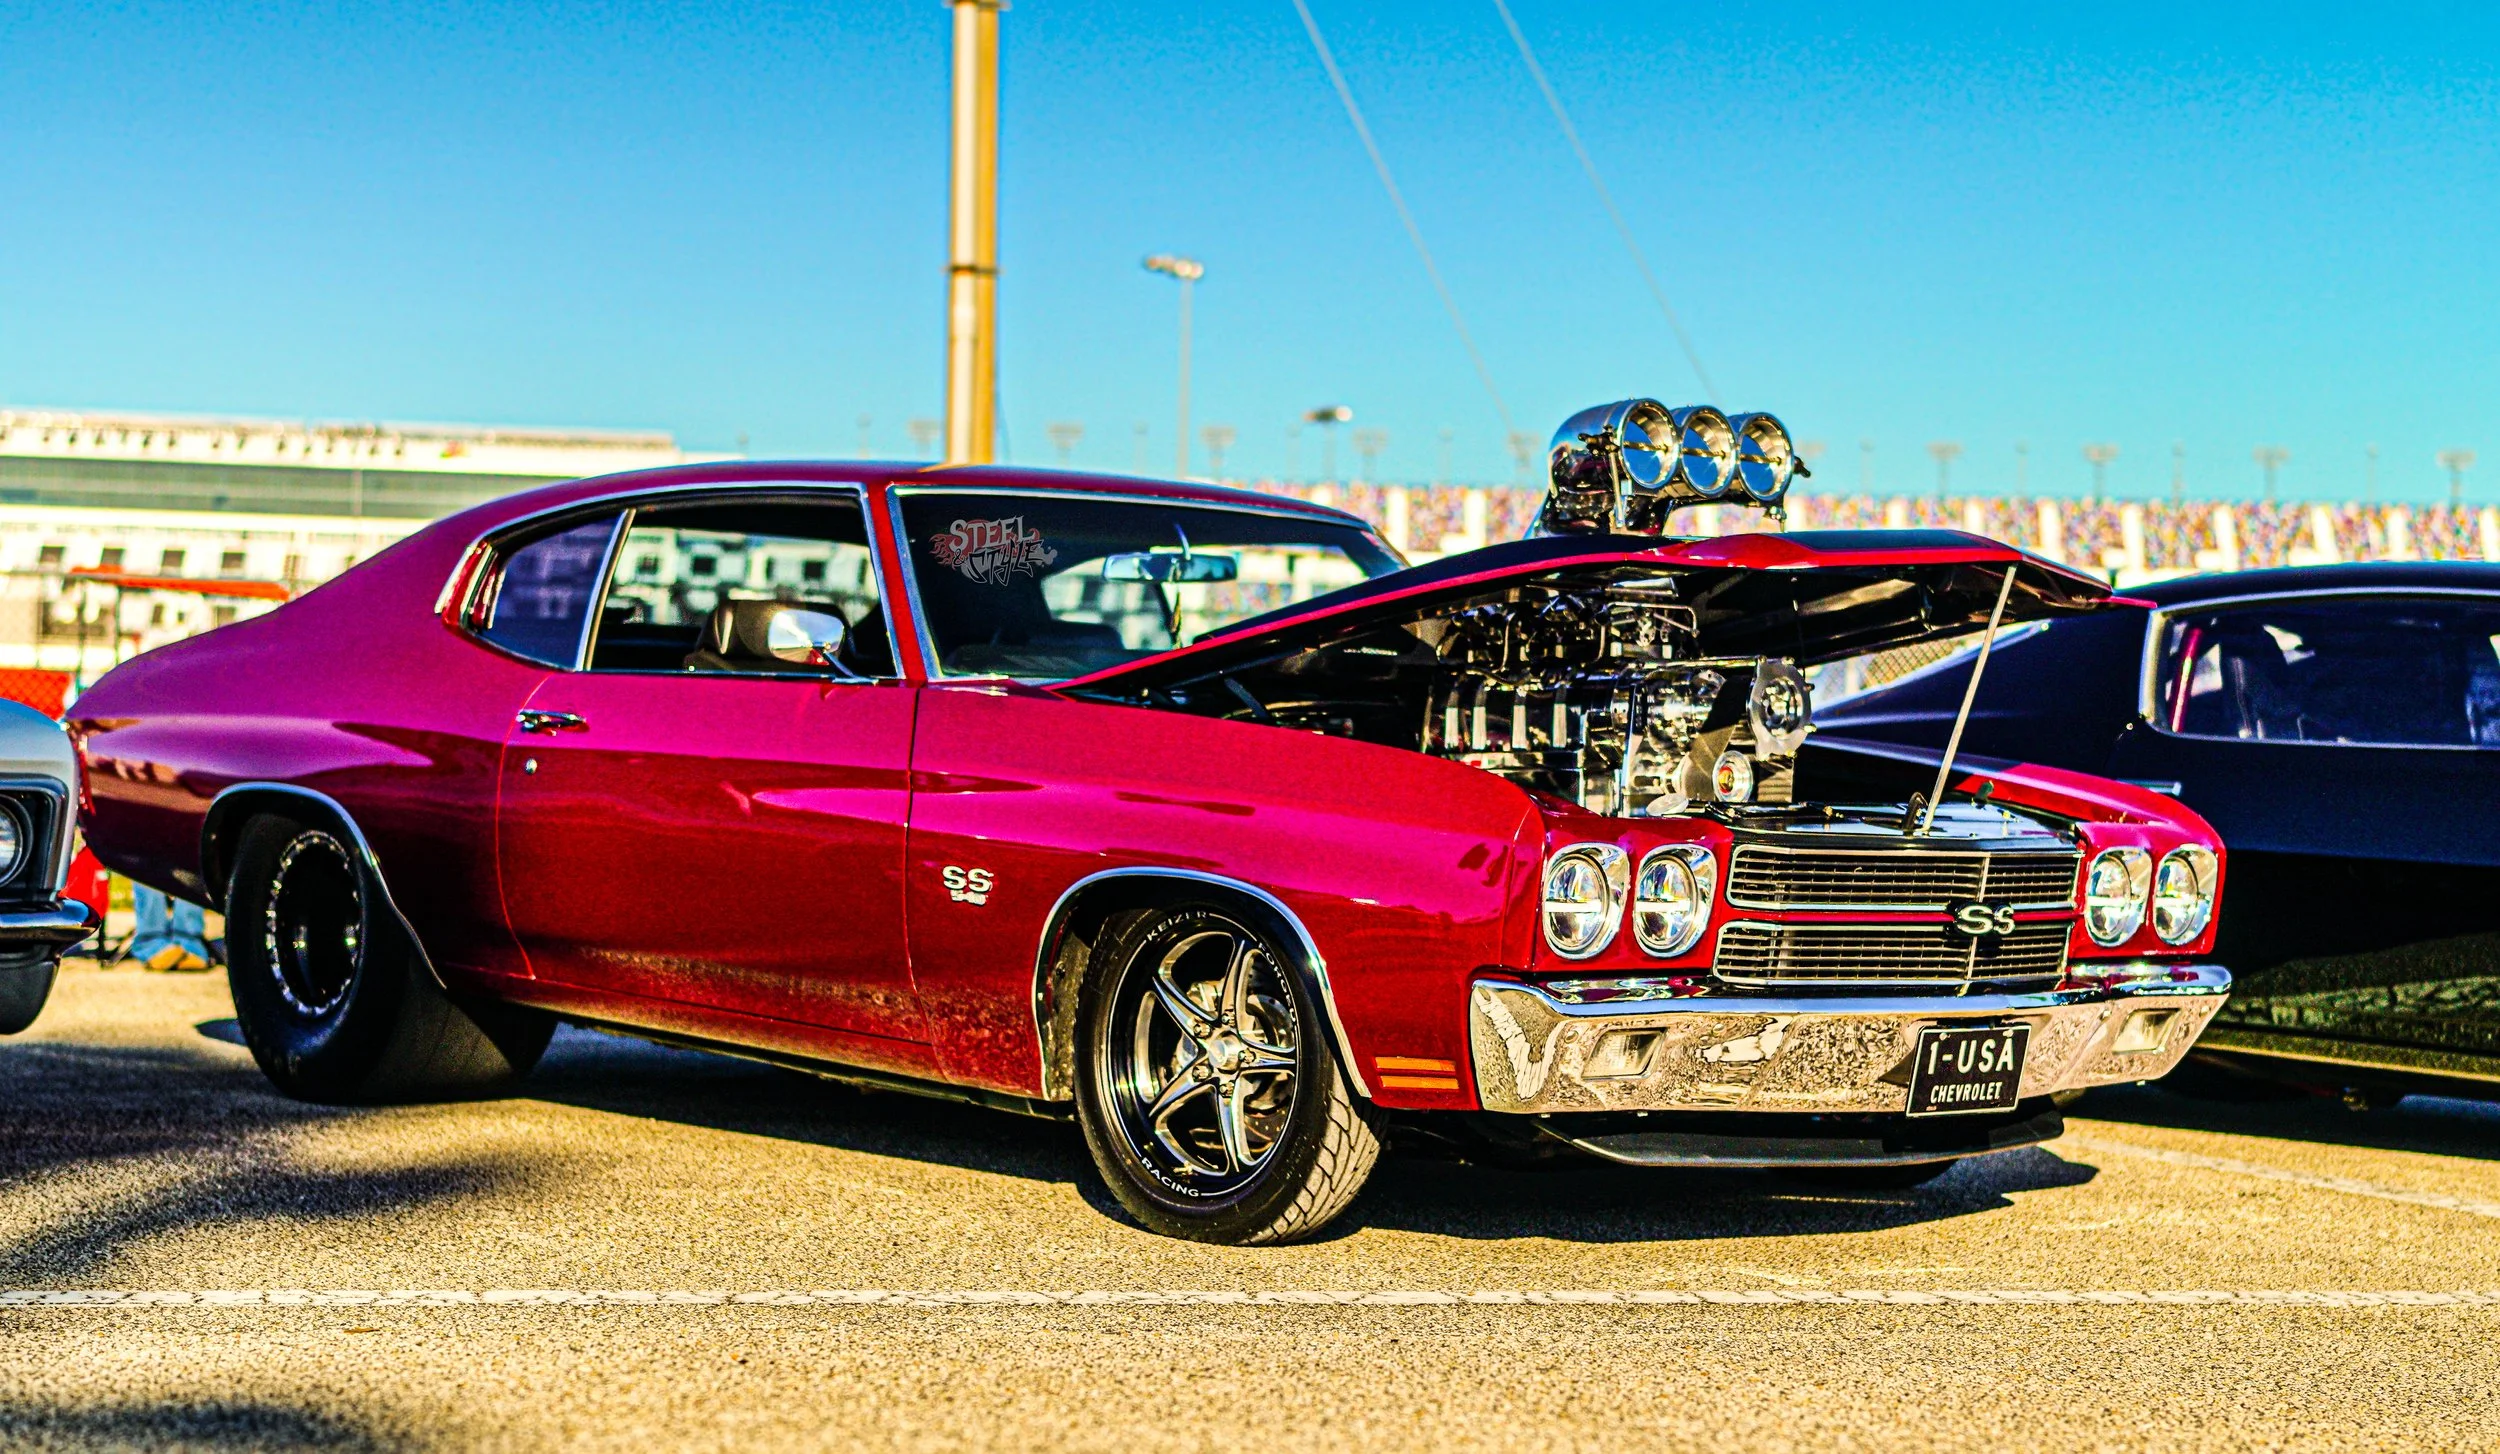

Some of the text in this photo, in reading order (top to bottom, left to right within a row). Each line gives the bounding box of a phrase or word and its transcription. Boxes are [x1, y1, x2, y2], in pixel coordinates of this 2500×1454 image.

[942, 865, 994, 892] SS
[1957, 904, 2016, 935] SS
[1927, 1037, 2014, 1075] 1-USA
[1930, 1082, 2002, 1104] CHEVROLET
[1141, 1157, 1199, 1197] RACING
